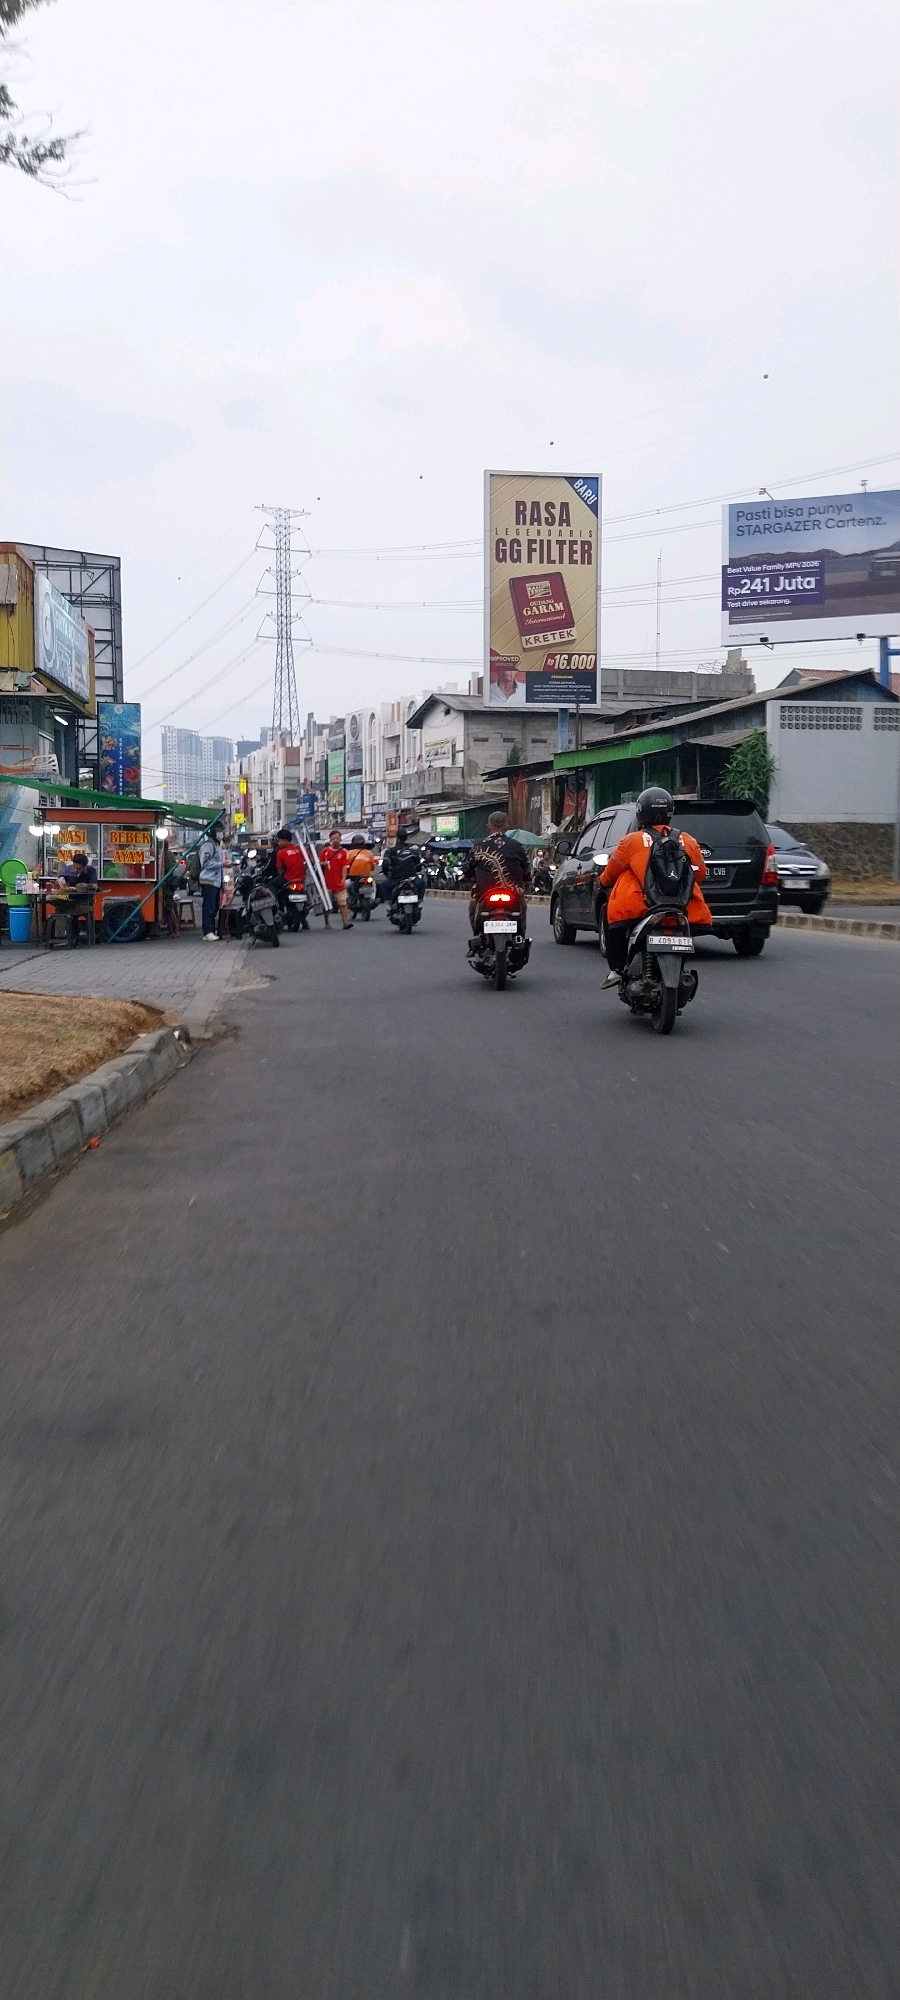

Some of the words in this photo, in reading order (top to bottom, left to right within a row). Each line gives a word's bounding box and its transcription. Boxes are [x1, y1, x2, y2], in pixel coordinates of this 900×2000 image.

[573, 478, 598, 505] BARU
[515, 500, 571, 527] RASA
[736, 507, 771, 523] Pasti
[775, 504, 803, 519] bisa
[808, 502, 853, 518] punya
[495, 528, 593, 538] LEGENDARIS
[736, 519, 822, 537] STARGAZER
[825, 516, 887, 530] Cartenz.
[495, 538, 522, 563] GG
[527, 538, 593, 565] FILTER
[742, 565, 761, 573] Value
[762, 563, 785, 571] Family
[523, 602, 565, 616] GARAM
[759, 598, 792, 606] sekarang.
[524, 630, 575, 646] KRETEK
[58, 830, 87, 843] NASI
[110, 831, 150, 844] BEBEK
[113, 850, 145, 863] AYAM
[713, 867, 726, 876] CVB
